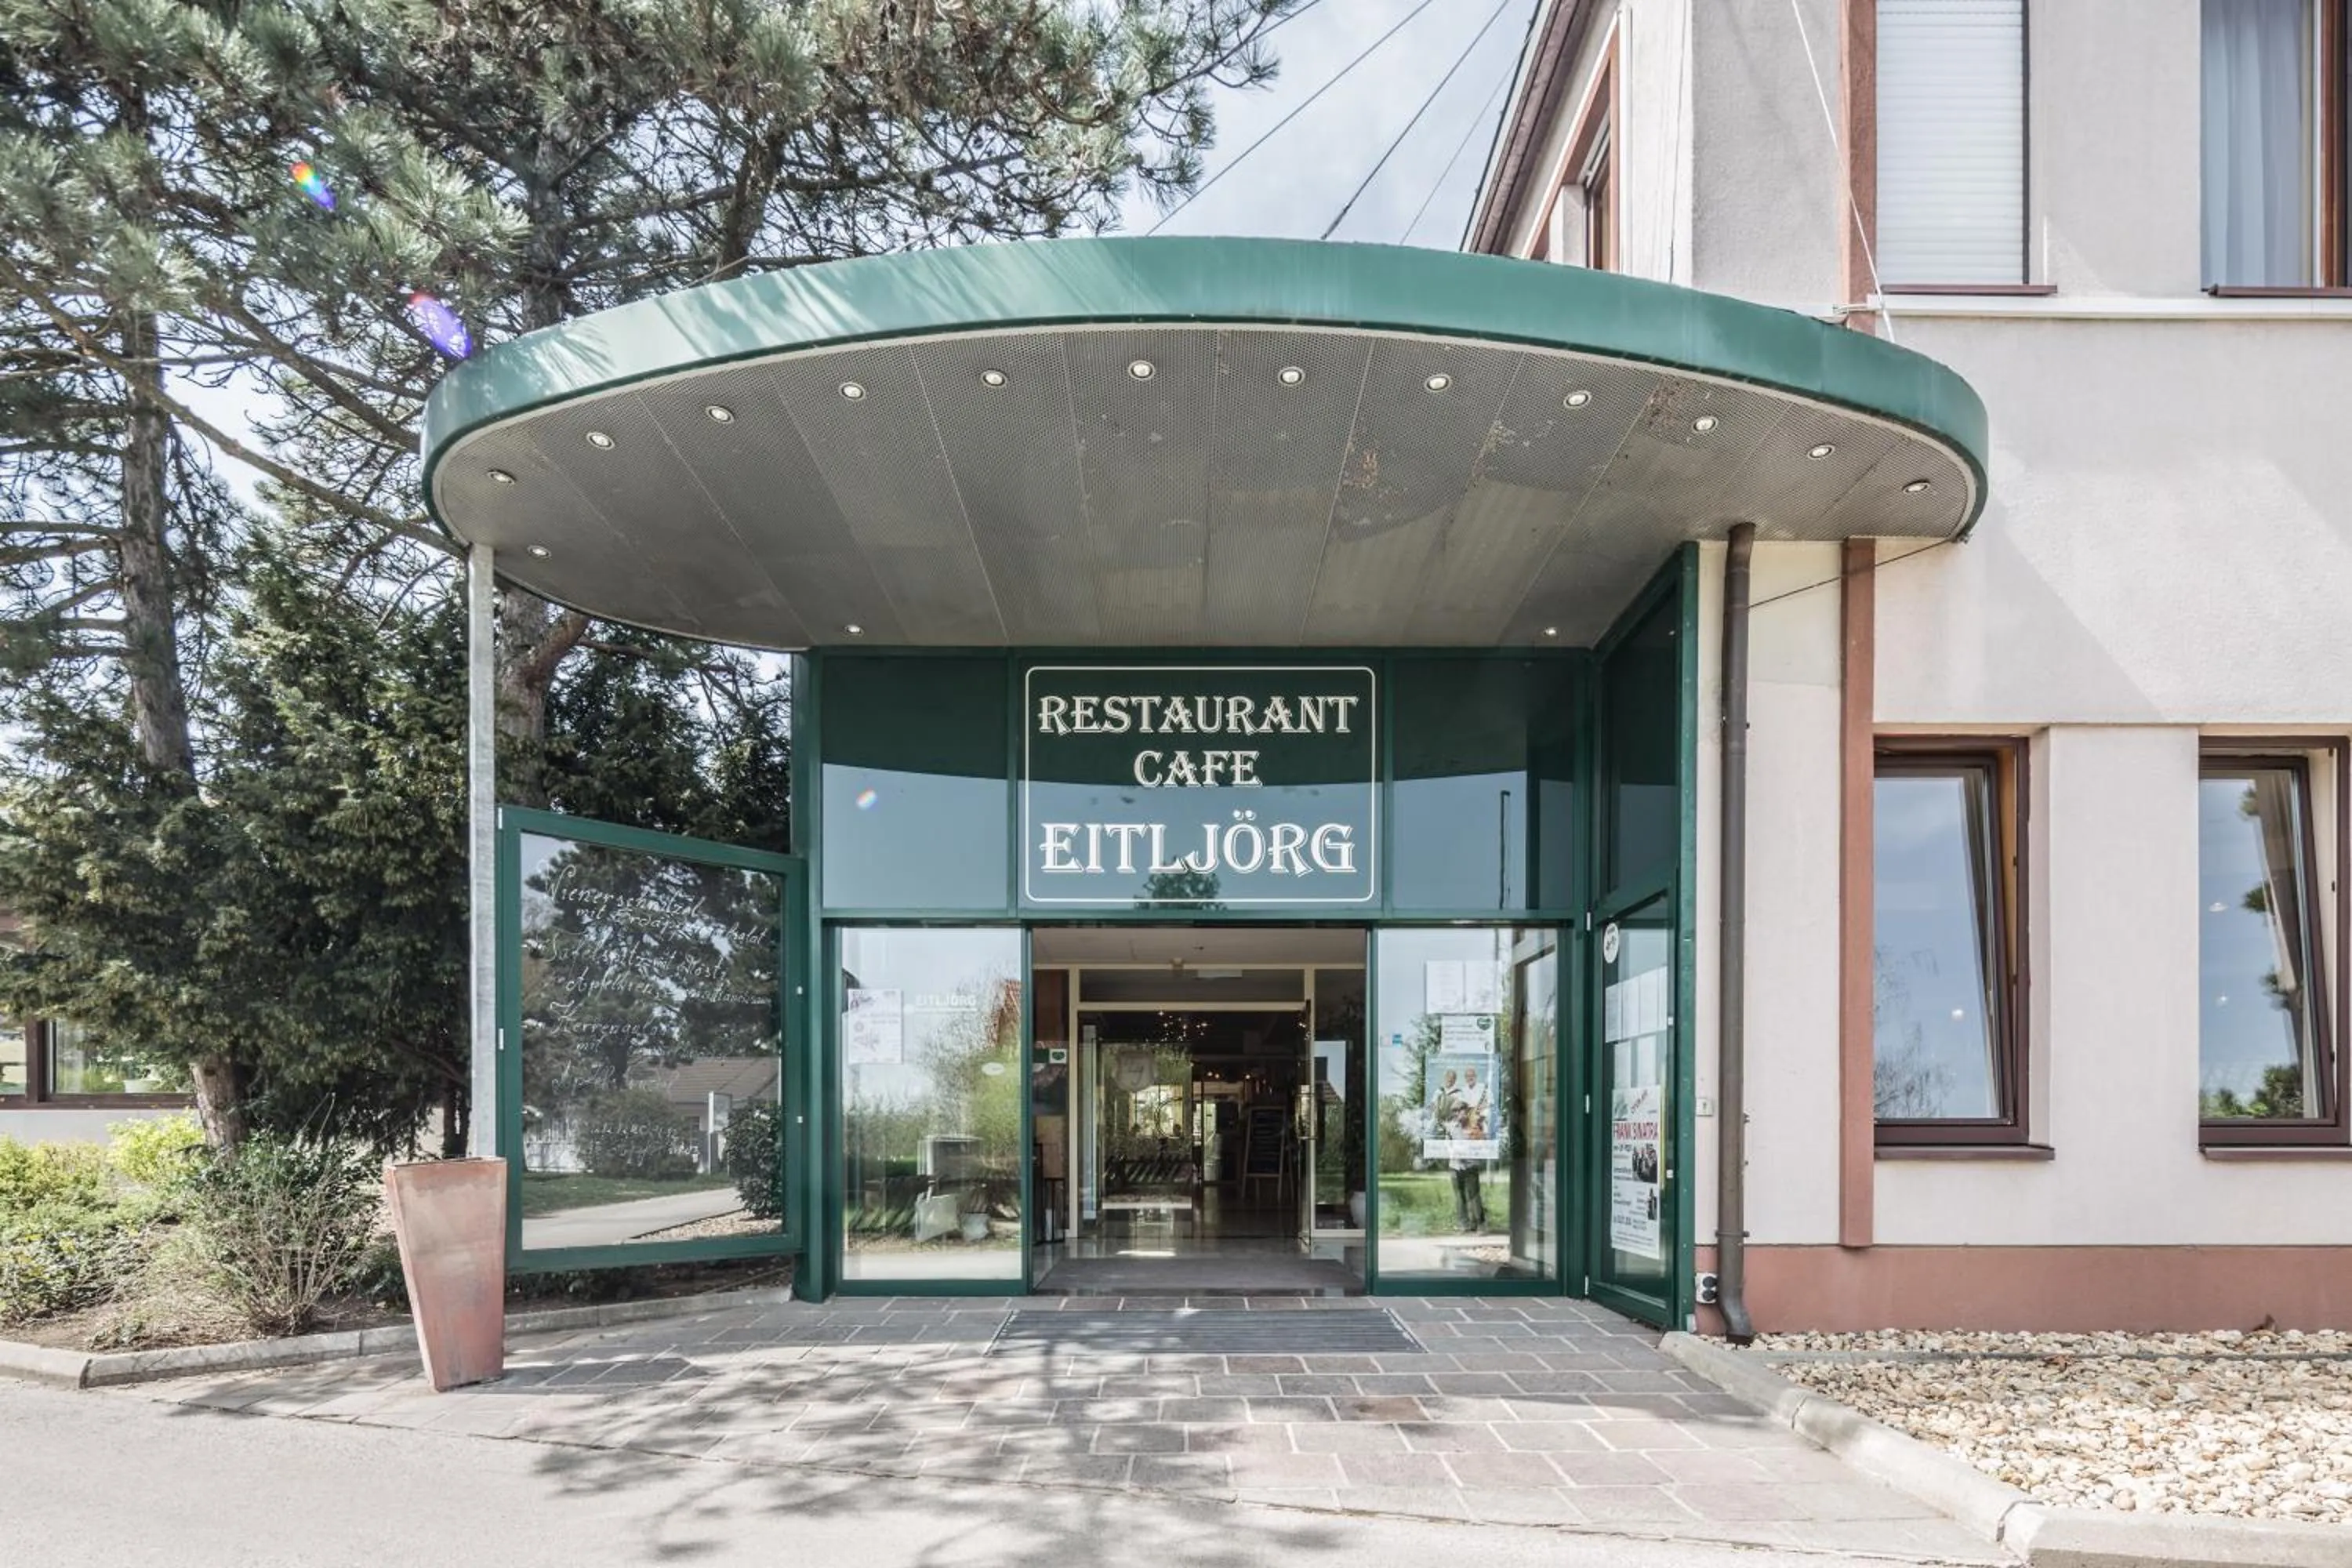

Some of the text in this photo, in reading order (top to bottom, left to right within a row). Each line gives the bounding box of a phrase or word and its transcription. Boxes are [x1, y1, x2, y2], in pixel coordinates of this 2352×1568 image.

[1037, 695, 1359, 735] RESTAURANT
[1134, 750, 1263, 788] CAFE
[1039, 810, 1358, 877] EITLJÖRG
